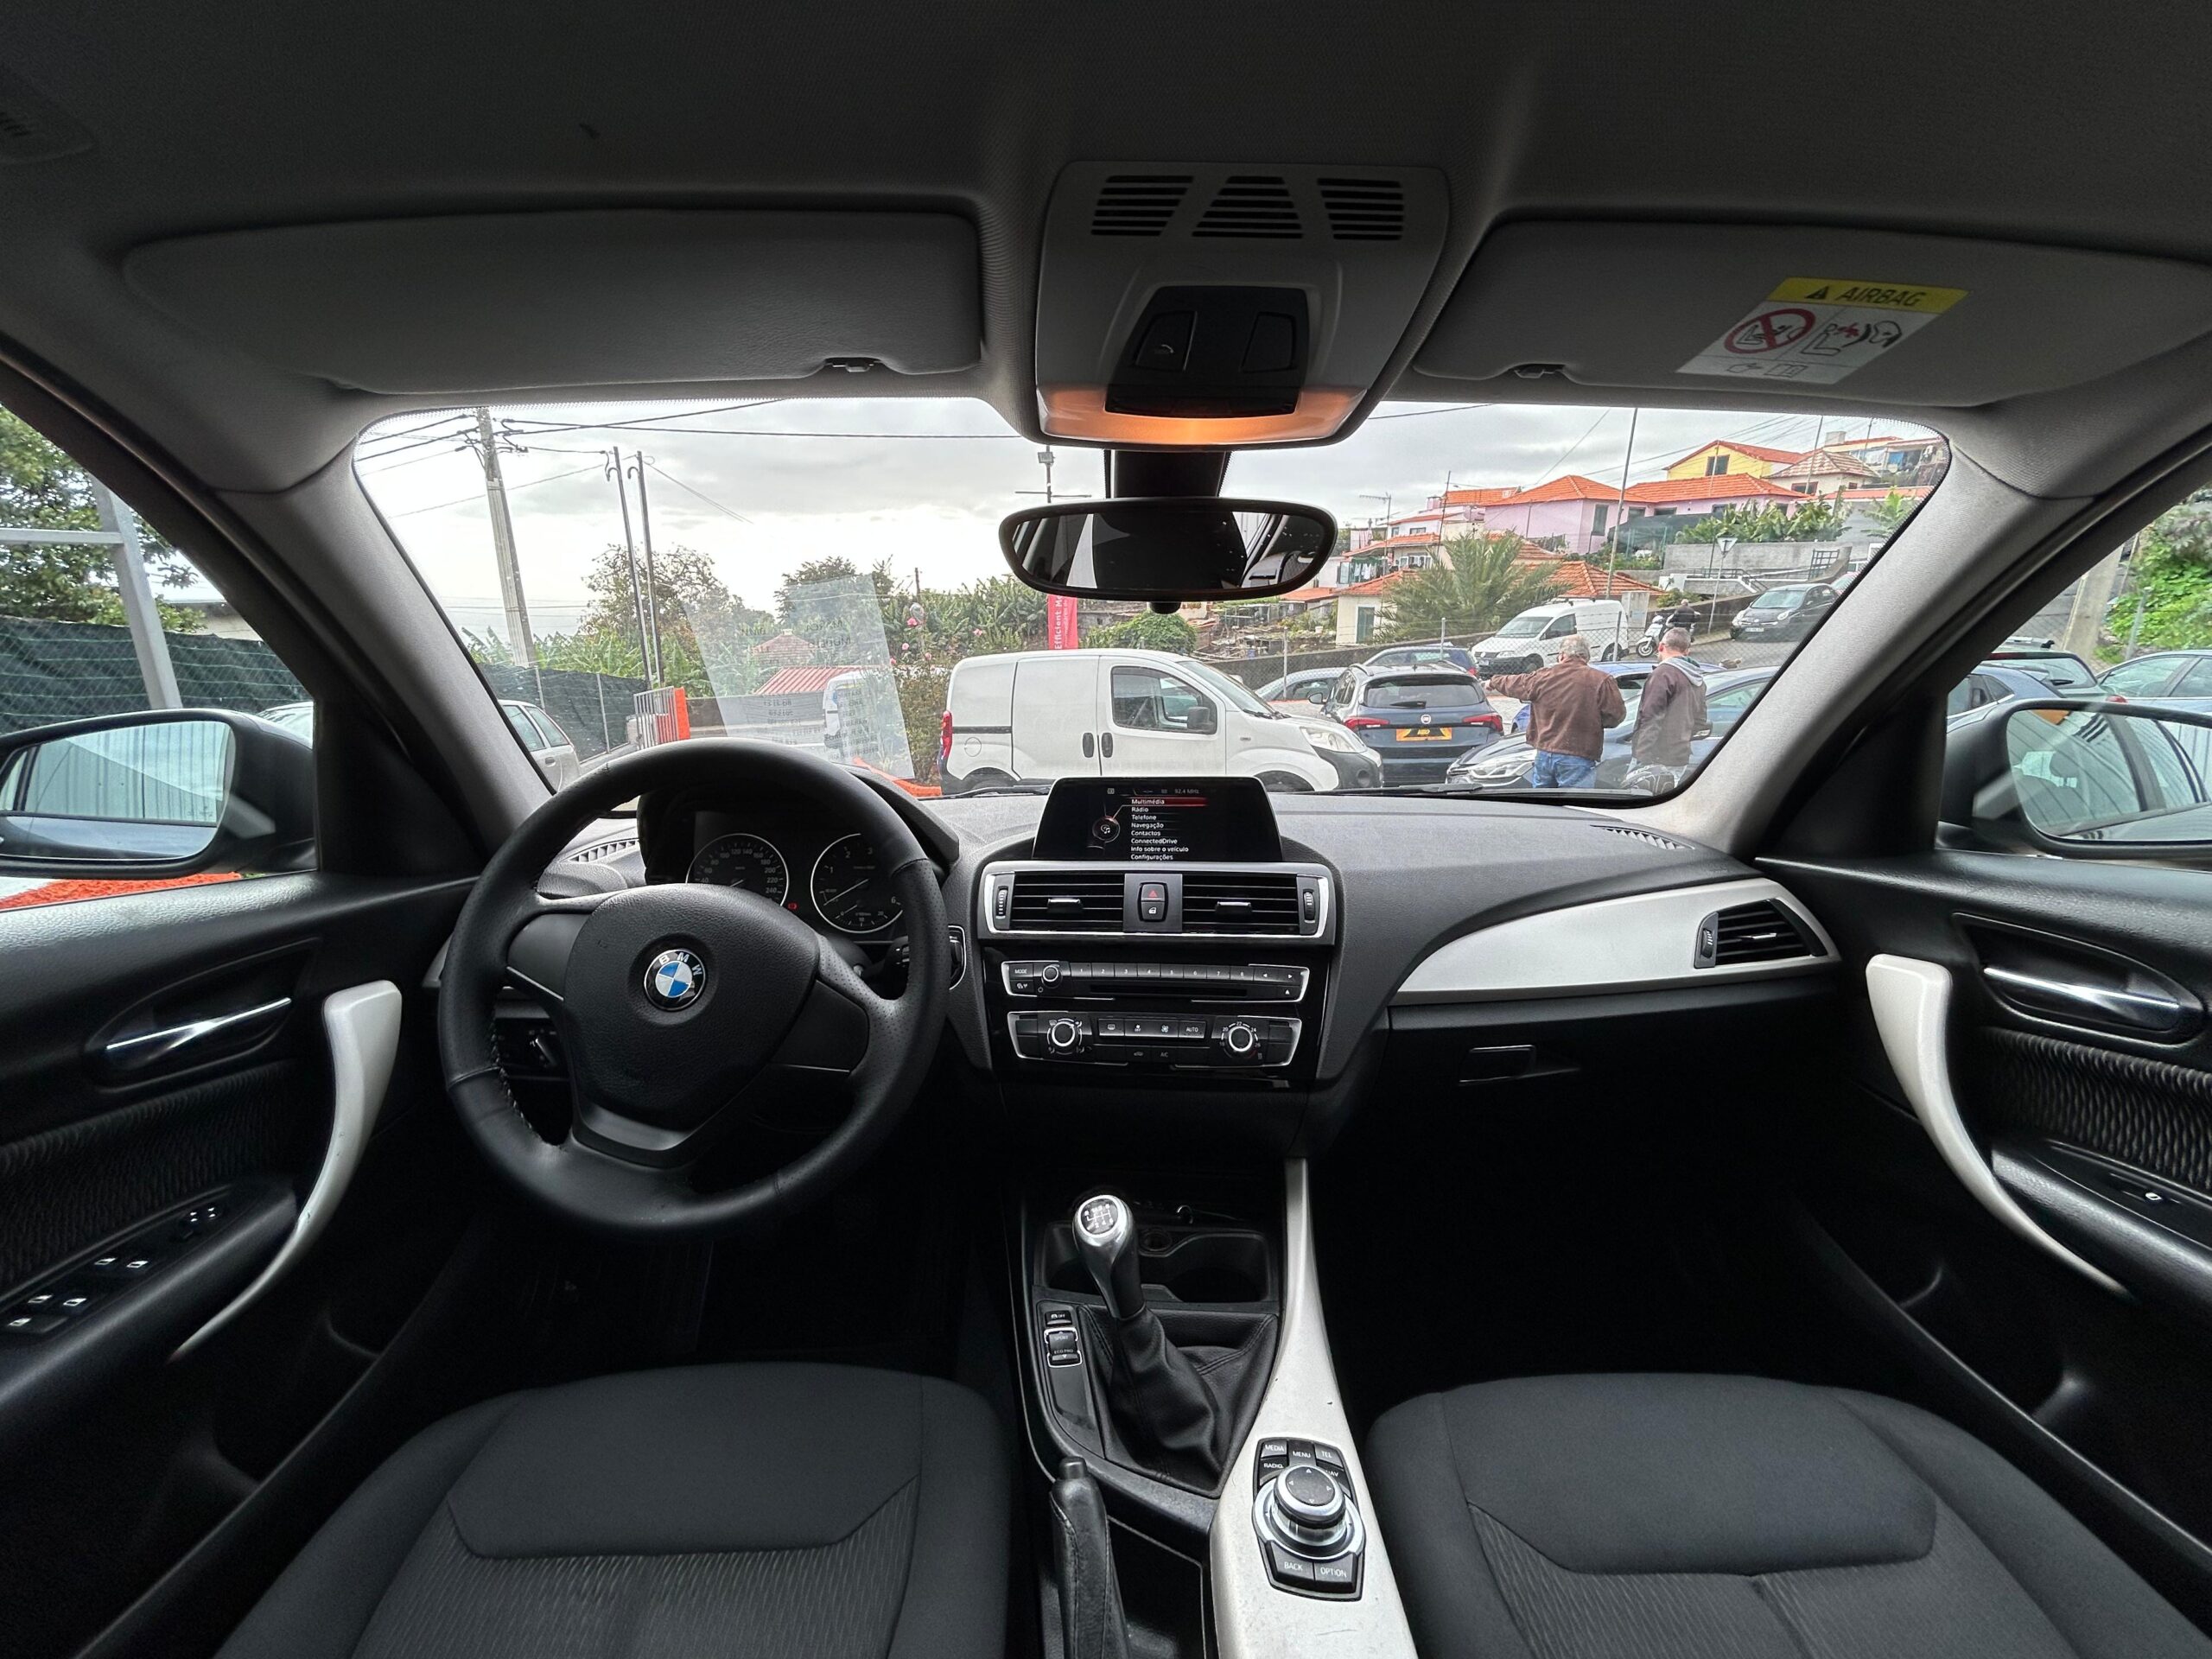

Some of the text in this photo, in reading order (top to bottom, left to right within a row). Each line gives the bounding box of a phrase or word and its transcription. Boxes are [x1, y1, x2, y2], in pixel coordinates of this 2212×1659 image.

[1834, 287, 1927, 307] AIRBAG
[659, 952, 702, 976] BMW
[1284, 1561, 1303, 1572] BACK
[1320, 1567, 1347, 1578] OPTION
